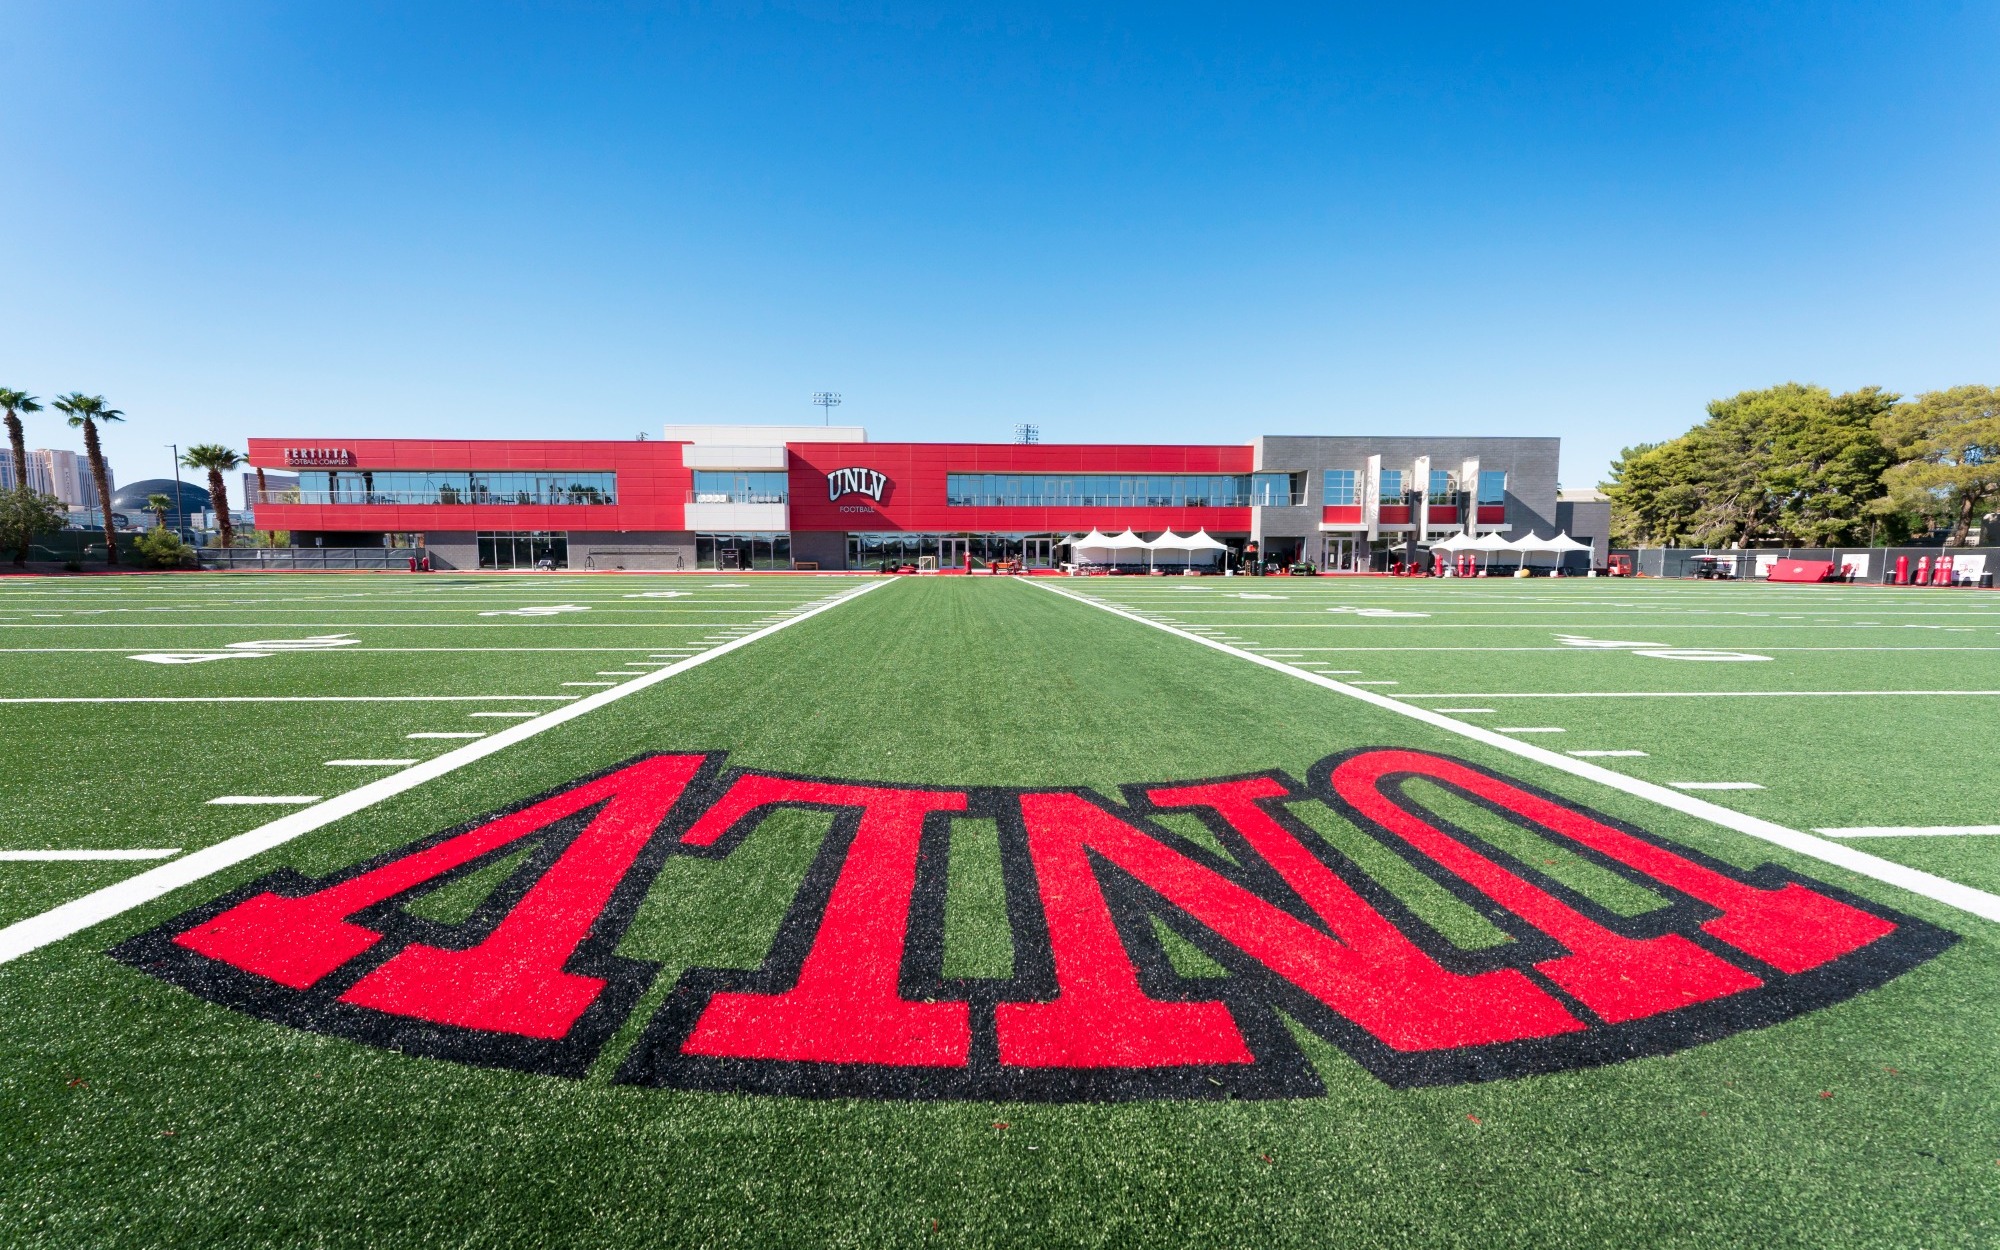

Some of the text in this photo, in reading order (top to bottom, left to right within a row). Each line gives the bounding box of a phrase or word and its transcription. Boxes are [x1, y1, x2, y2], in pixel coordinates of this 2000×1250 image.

[284, 447, 348, 458] FERTITTA
[827, 467, 887, 502] UNLV
[165, 750, 1900, 1070] UNLV
